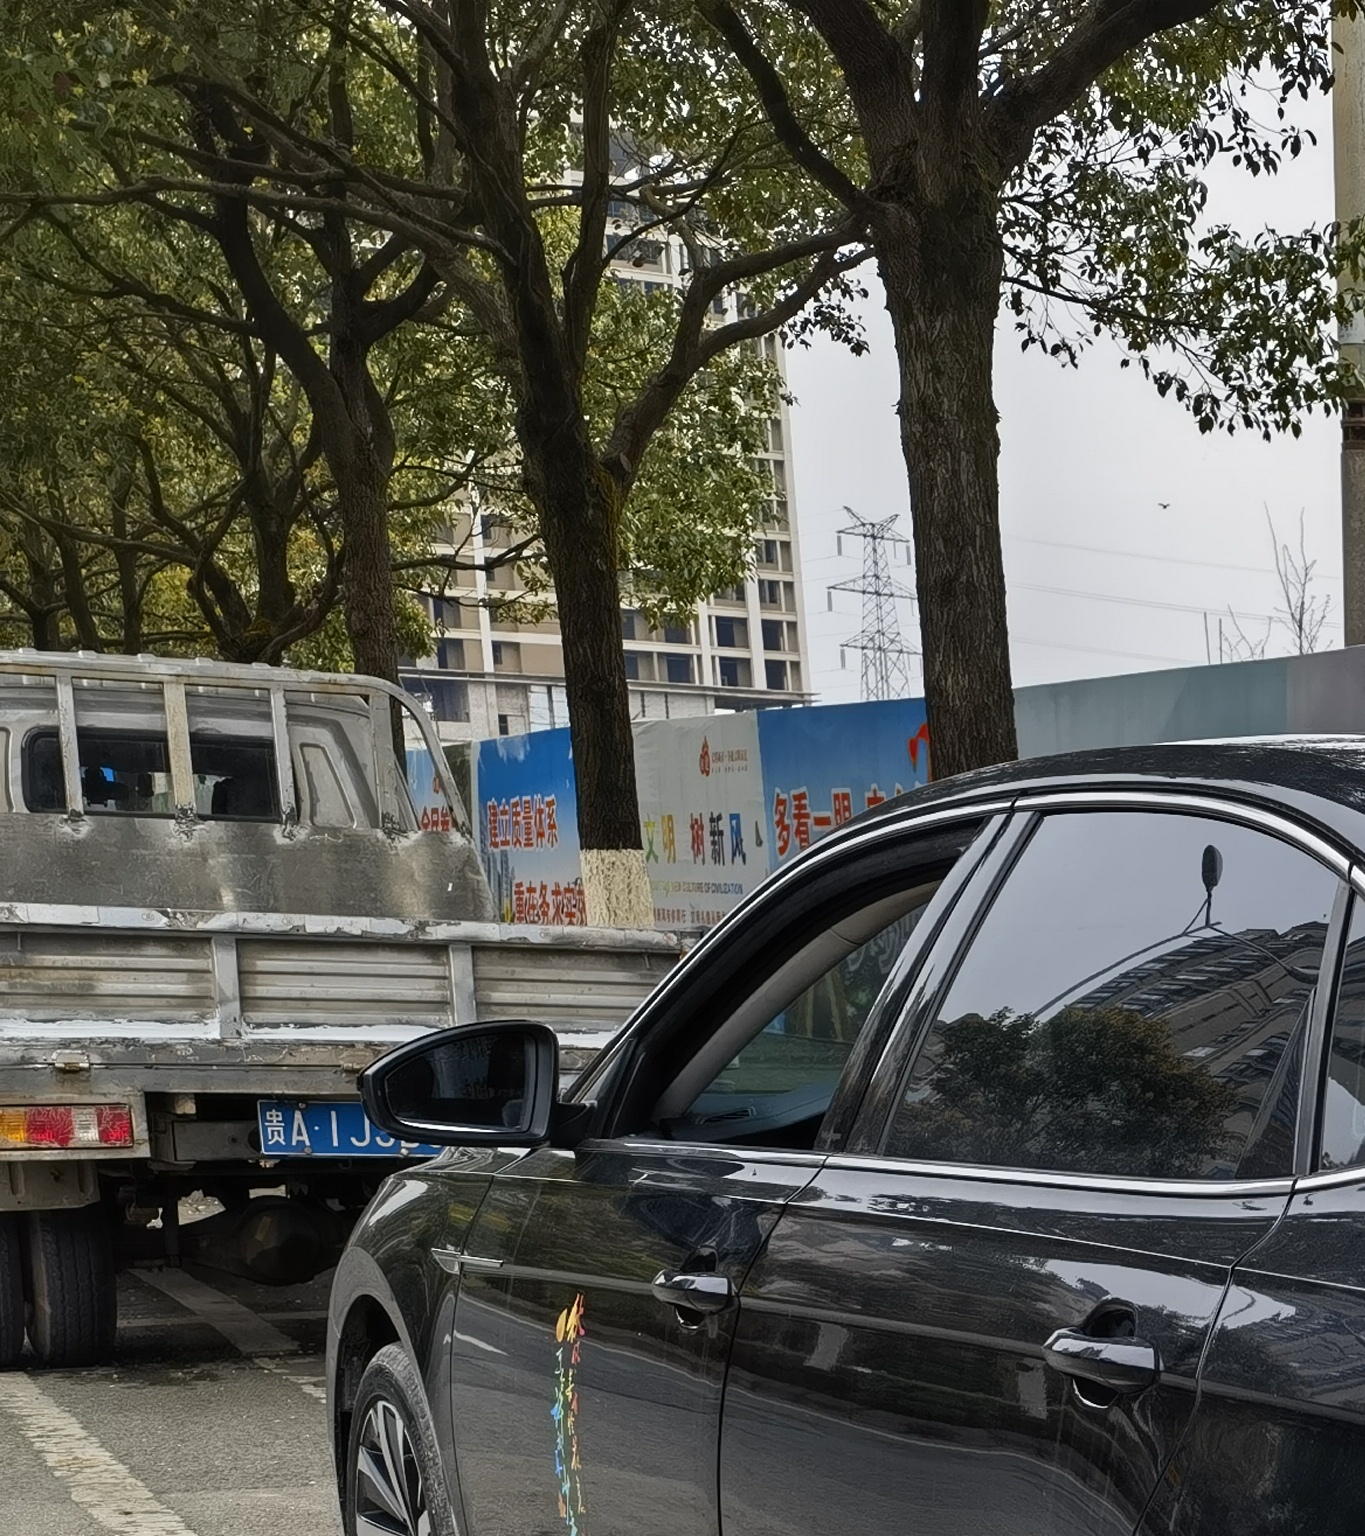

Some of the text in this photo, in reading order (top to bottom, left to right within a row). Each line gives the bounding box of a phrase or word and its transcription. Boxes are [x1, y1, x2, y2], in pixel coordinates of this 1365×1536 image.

[488, 798, 558, 849] 建立质量体系
